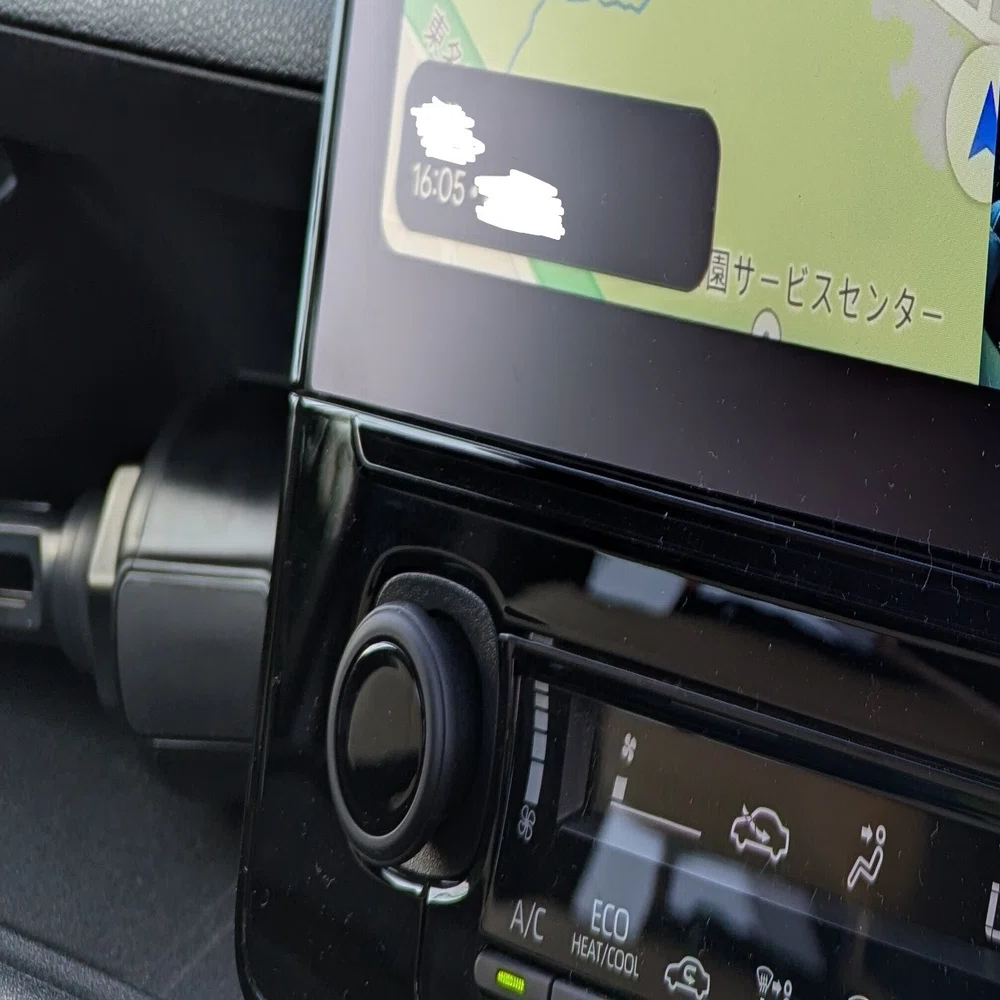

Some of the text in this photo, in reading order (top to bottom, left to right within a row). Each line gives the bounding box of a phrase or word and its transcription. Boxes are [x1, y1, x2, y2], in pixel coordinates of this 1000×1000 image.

[412, 162, 467, 206] 16:05
[706, 249, 943, 329] 園サービスセンター
[510, 899, 547, 942] A/C
[590, 898, 630, 942] ECO
[570, 932, 640, 978] HEAT/COOL
